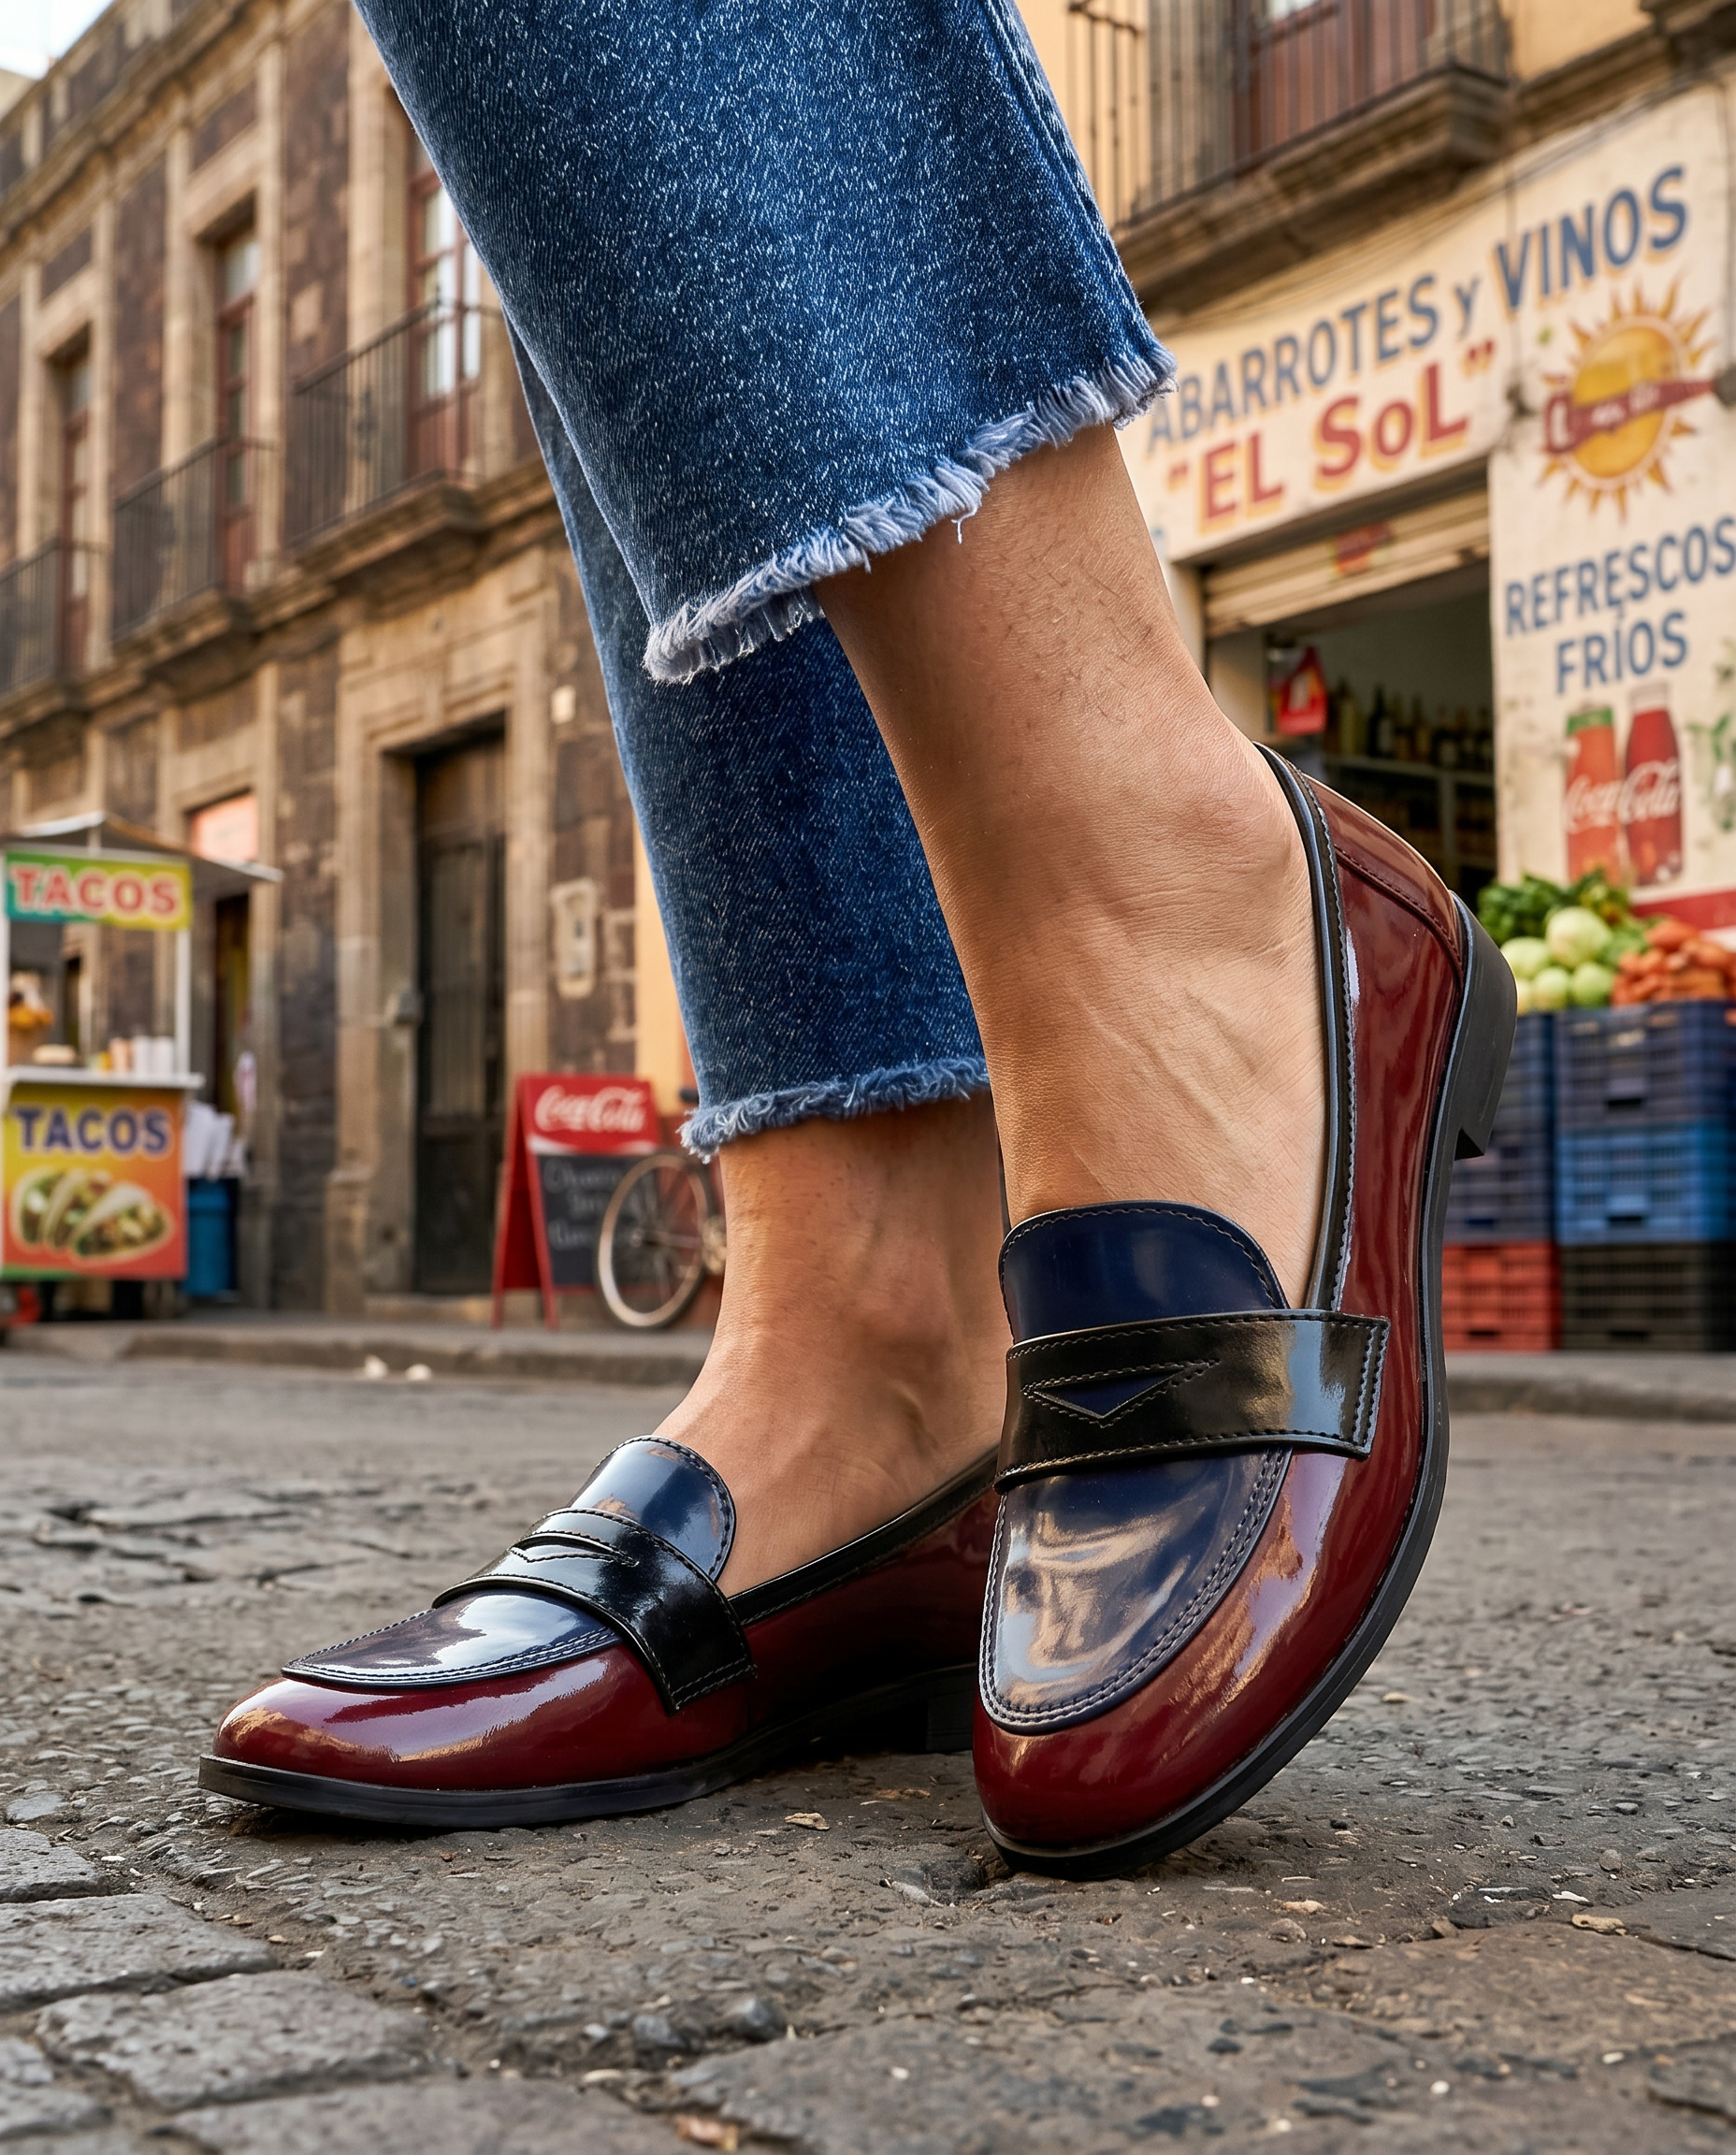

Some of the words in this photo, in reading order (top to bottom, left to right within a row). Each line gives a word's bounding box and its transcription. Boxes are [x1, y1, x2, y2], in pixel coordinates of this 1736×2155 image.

[1147, 274, 1439, 454] ABARROTES
[1497, 166, 1687, 310] VINOS
[1506, 516, 1736, 638] REFRESCOS
[11, 864, 179, 915] TACOS
[16, 1108, 170, 1153] TACOS
